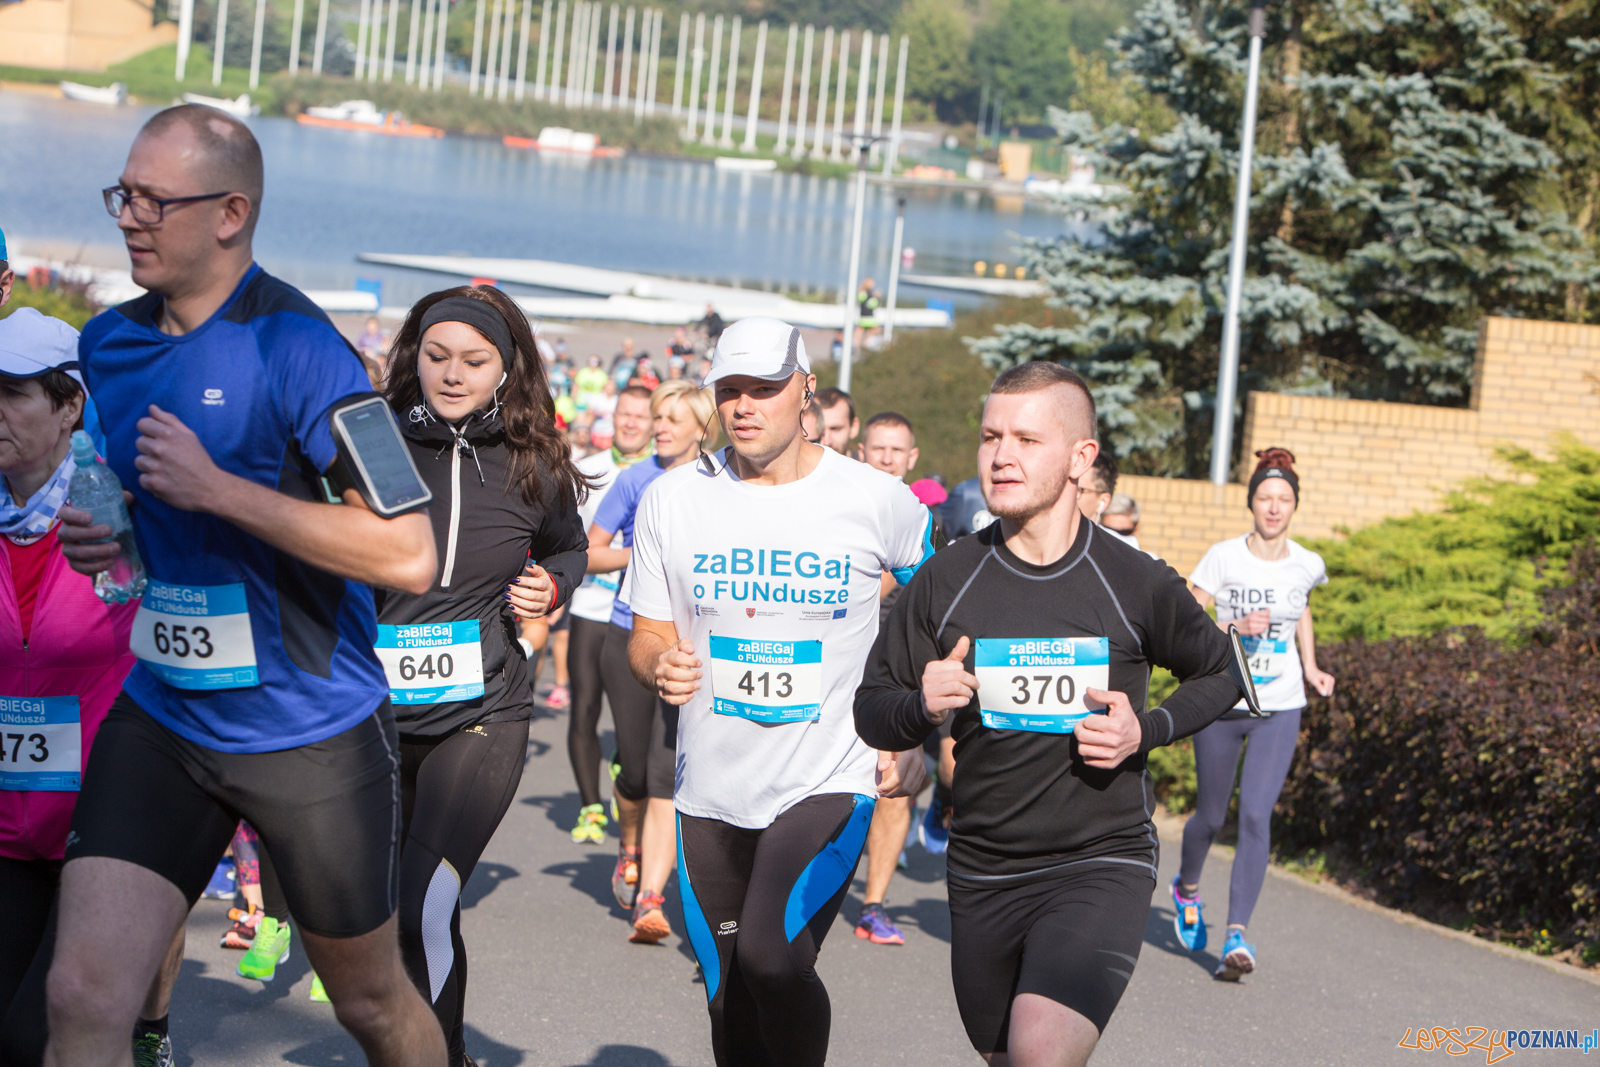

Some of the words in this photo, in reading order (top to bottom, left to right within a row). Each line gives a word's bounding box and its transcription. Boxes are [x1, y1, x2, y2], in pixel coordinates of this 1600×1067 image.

[693, 548, 851, 585] zaBIEGaj
[150, 586, 208, 606] zaBIEGaj
[693, 584, 705, 599] o
[714, 580, 849, 605] FUNdusze
[1229, 588, 1276, 604] RIDE
[157, 601, 208, 615] FUNdusze
[396, 624, 452, 638] zaBIEGaj
[153, 621, 214, 658] 653
[397, 640, 404, 648] o
[405, 637, 452, 648] FUNdusze
[737, 641, 794, 656] zaBIEGaj
[1009, 641, 1075, 656] zaBIEGaj
[745, 653, 794, 664] FUNdusze
[1009, 657, 1017, 666] o
[1019, 655, 1075, 666] FUNdusze
[399, 653, 454, 681] 640
[737, 670, 793, 698] 413
[1011, 675, 1075, 705] 370
[0, 713, 46, 724] UNdusze
